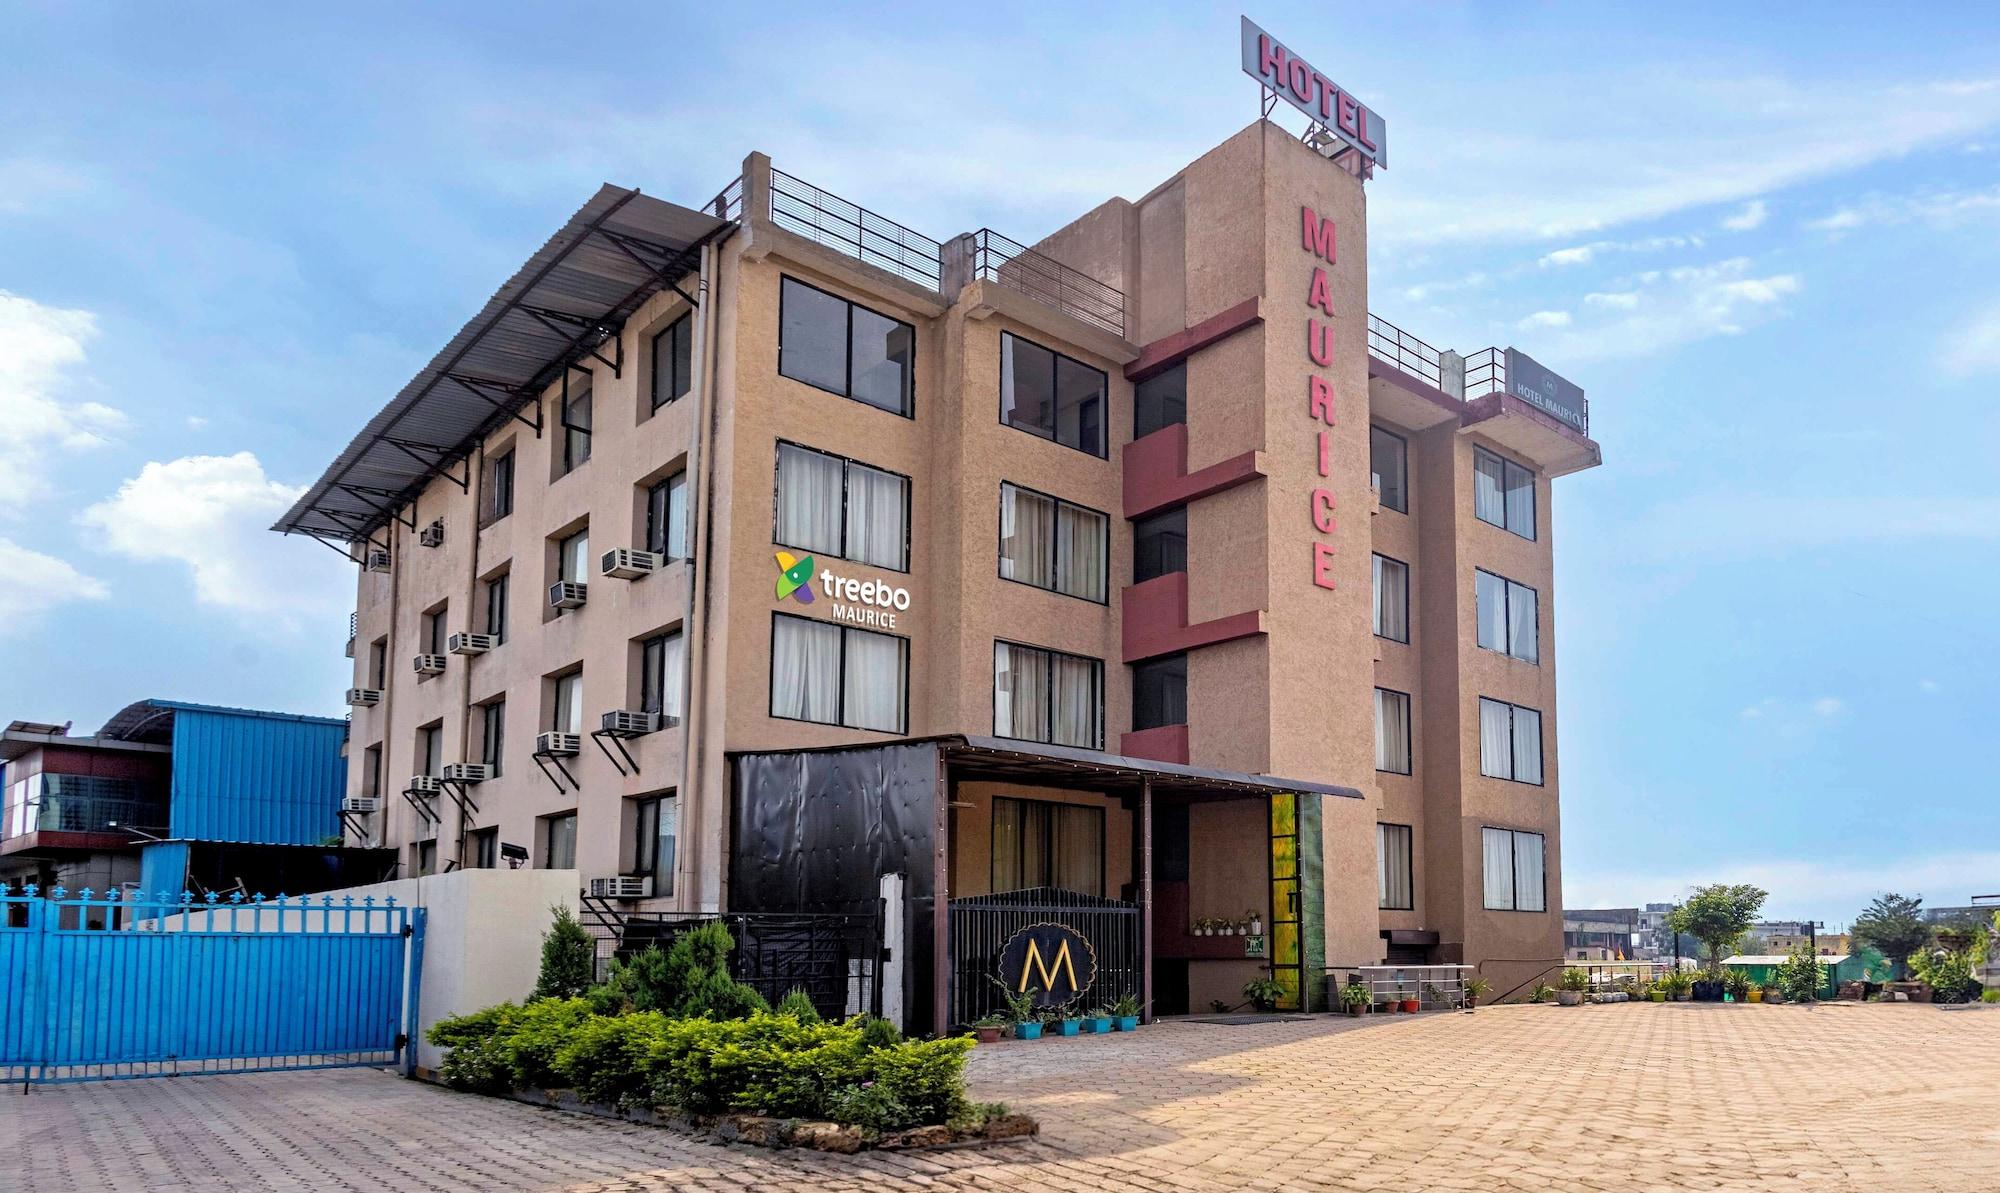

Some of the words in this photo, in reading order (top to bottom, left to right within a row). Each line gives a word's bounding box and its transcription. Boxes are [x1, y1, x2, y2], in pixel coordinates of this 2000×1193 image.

[1259, 32, 1377, 152] HOTEL
[1301, 206, 1337, 590] MAURICE
[1517, 383, 1544, 406] HOTEL
[820, 569, 911, 611] treebo
[832, 604, 896, 629] MAURICE
[1018, 938, 1078, 993] M
